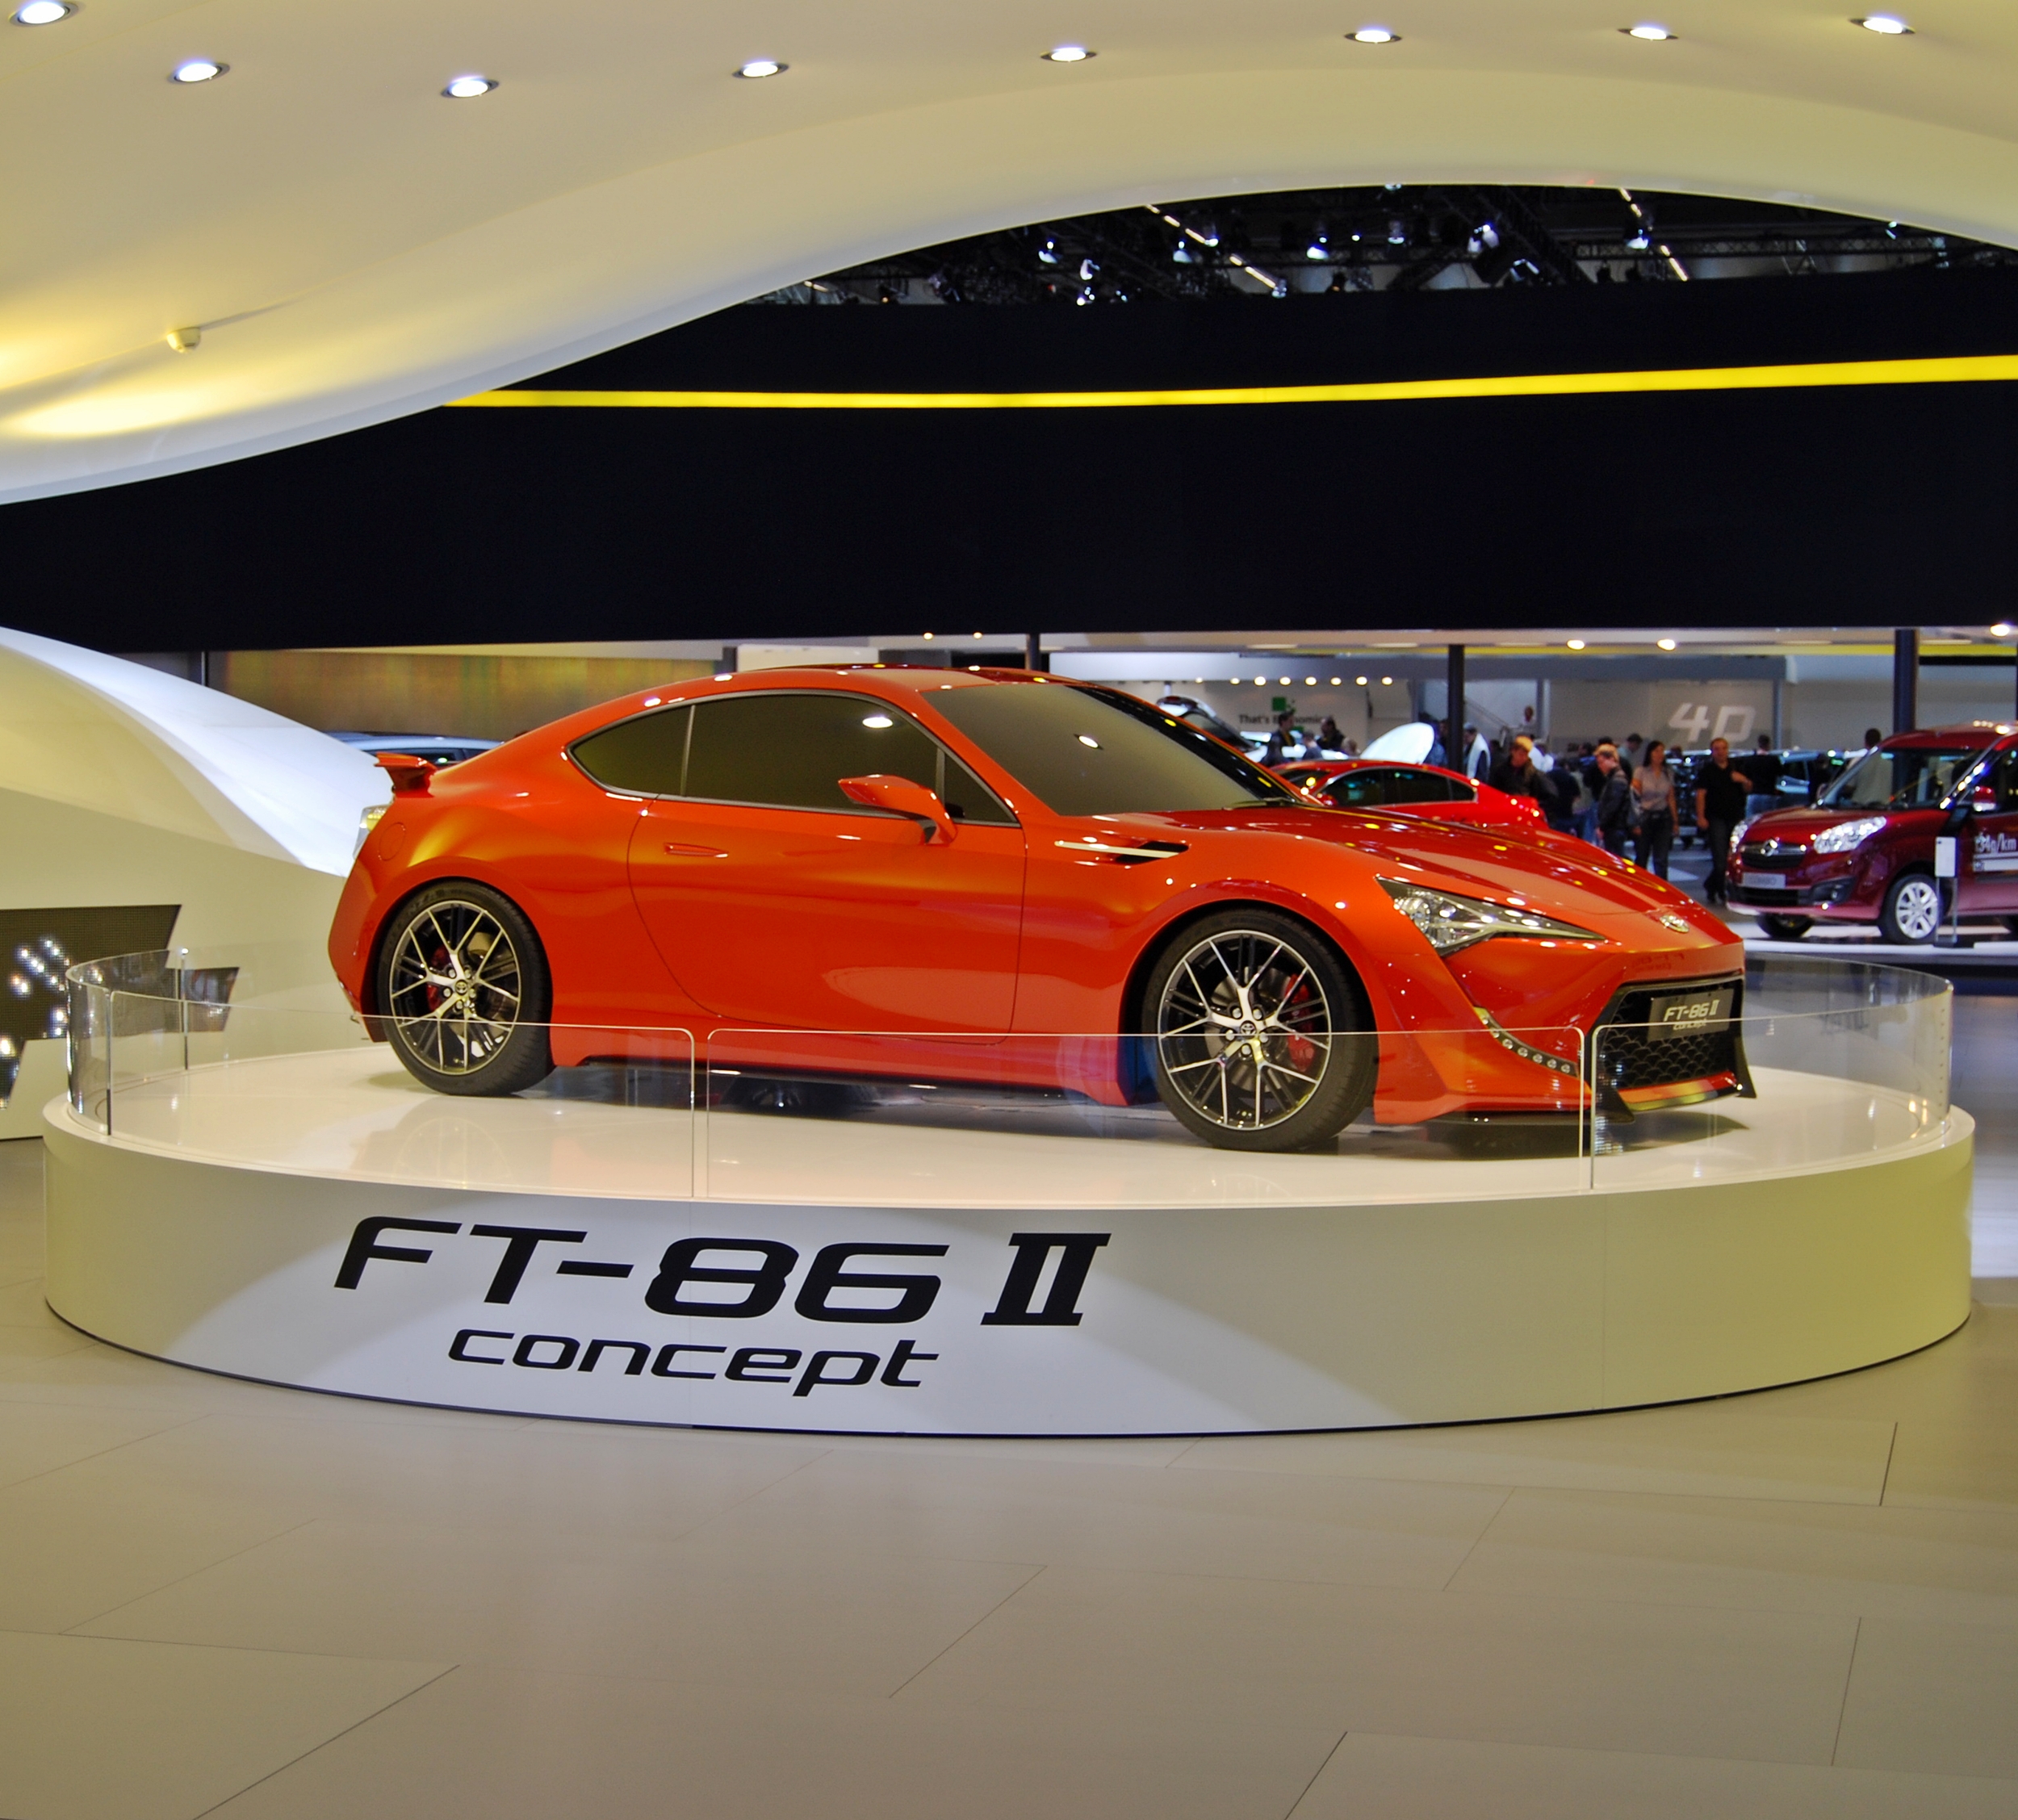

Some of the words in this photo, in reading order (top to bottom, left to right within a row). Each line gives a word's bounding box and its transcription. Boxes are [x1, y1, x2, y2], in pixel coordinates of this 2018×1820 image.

[1668, 702, 1756, 742] 4D
[1664, 1002, 1710, 1022] FT-86
[334, 1216, 949, 1323] FT-86
[981, 1233, 1111, 1325] II
[449, 1329, 939, 1396] concept
